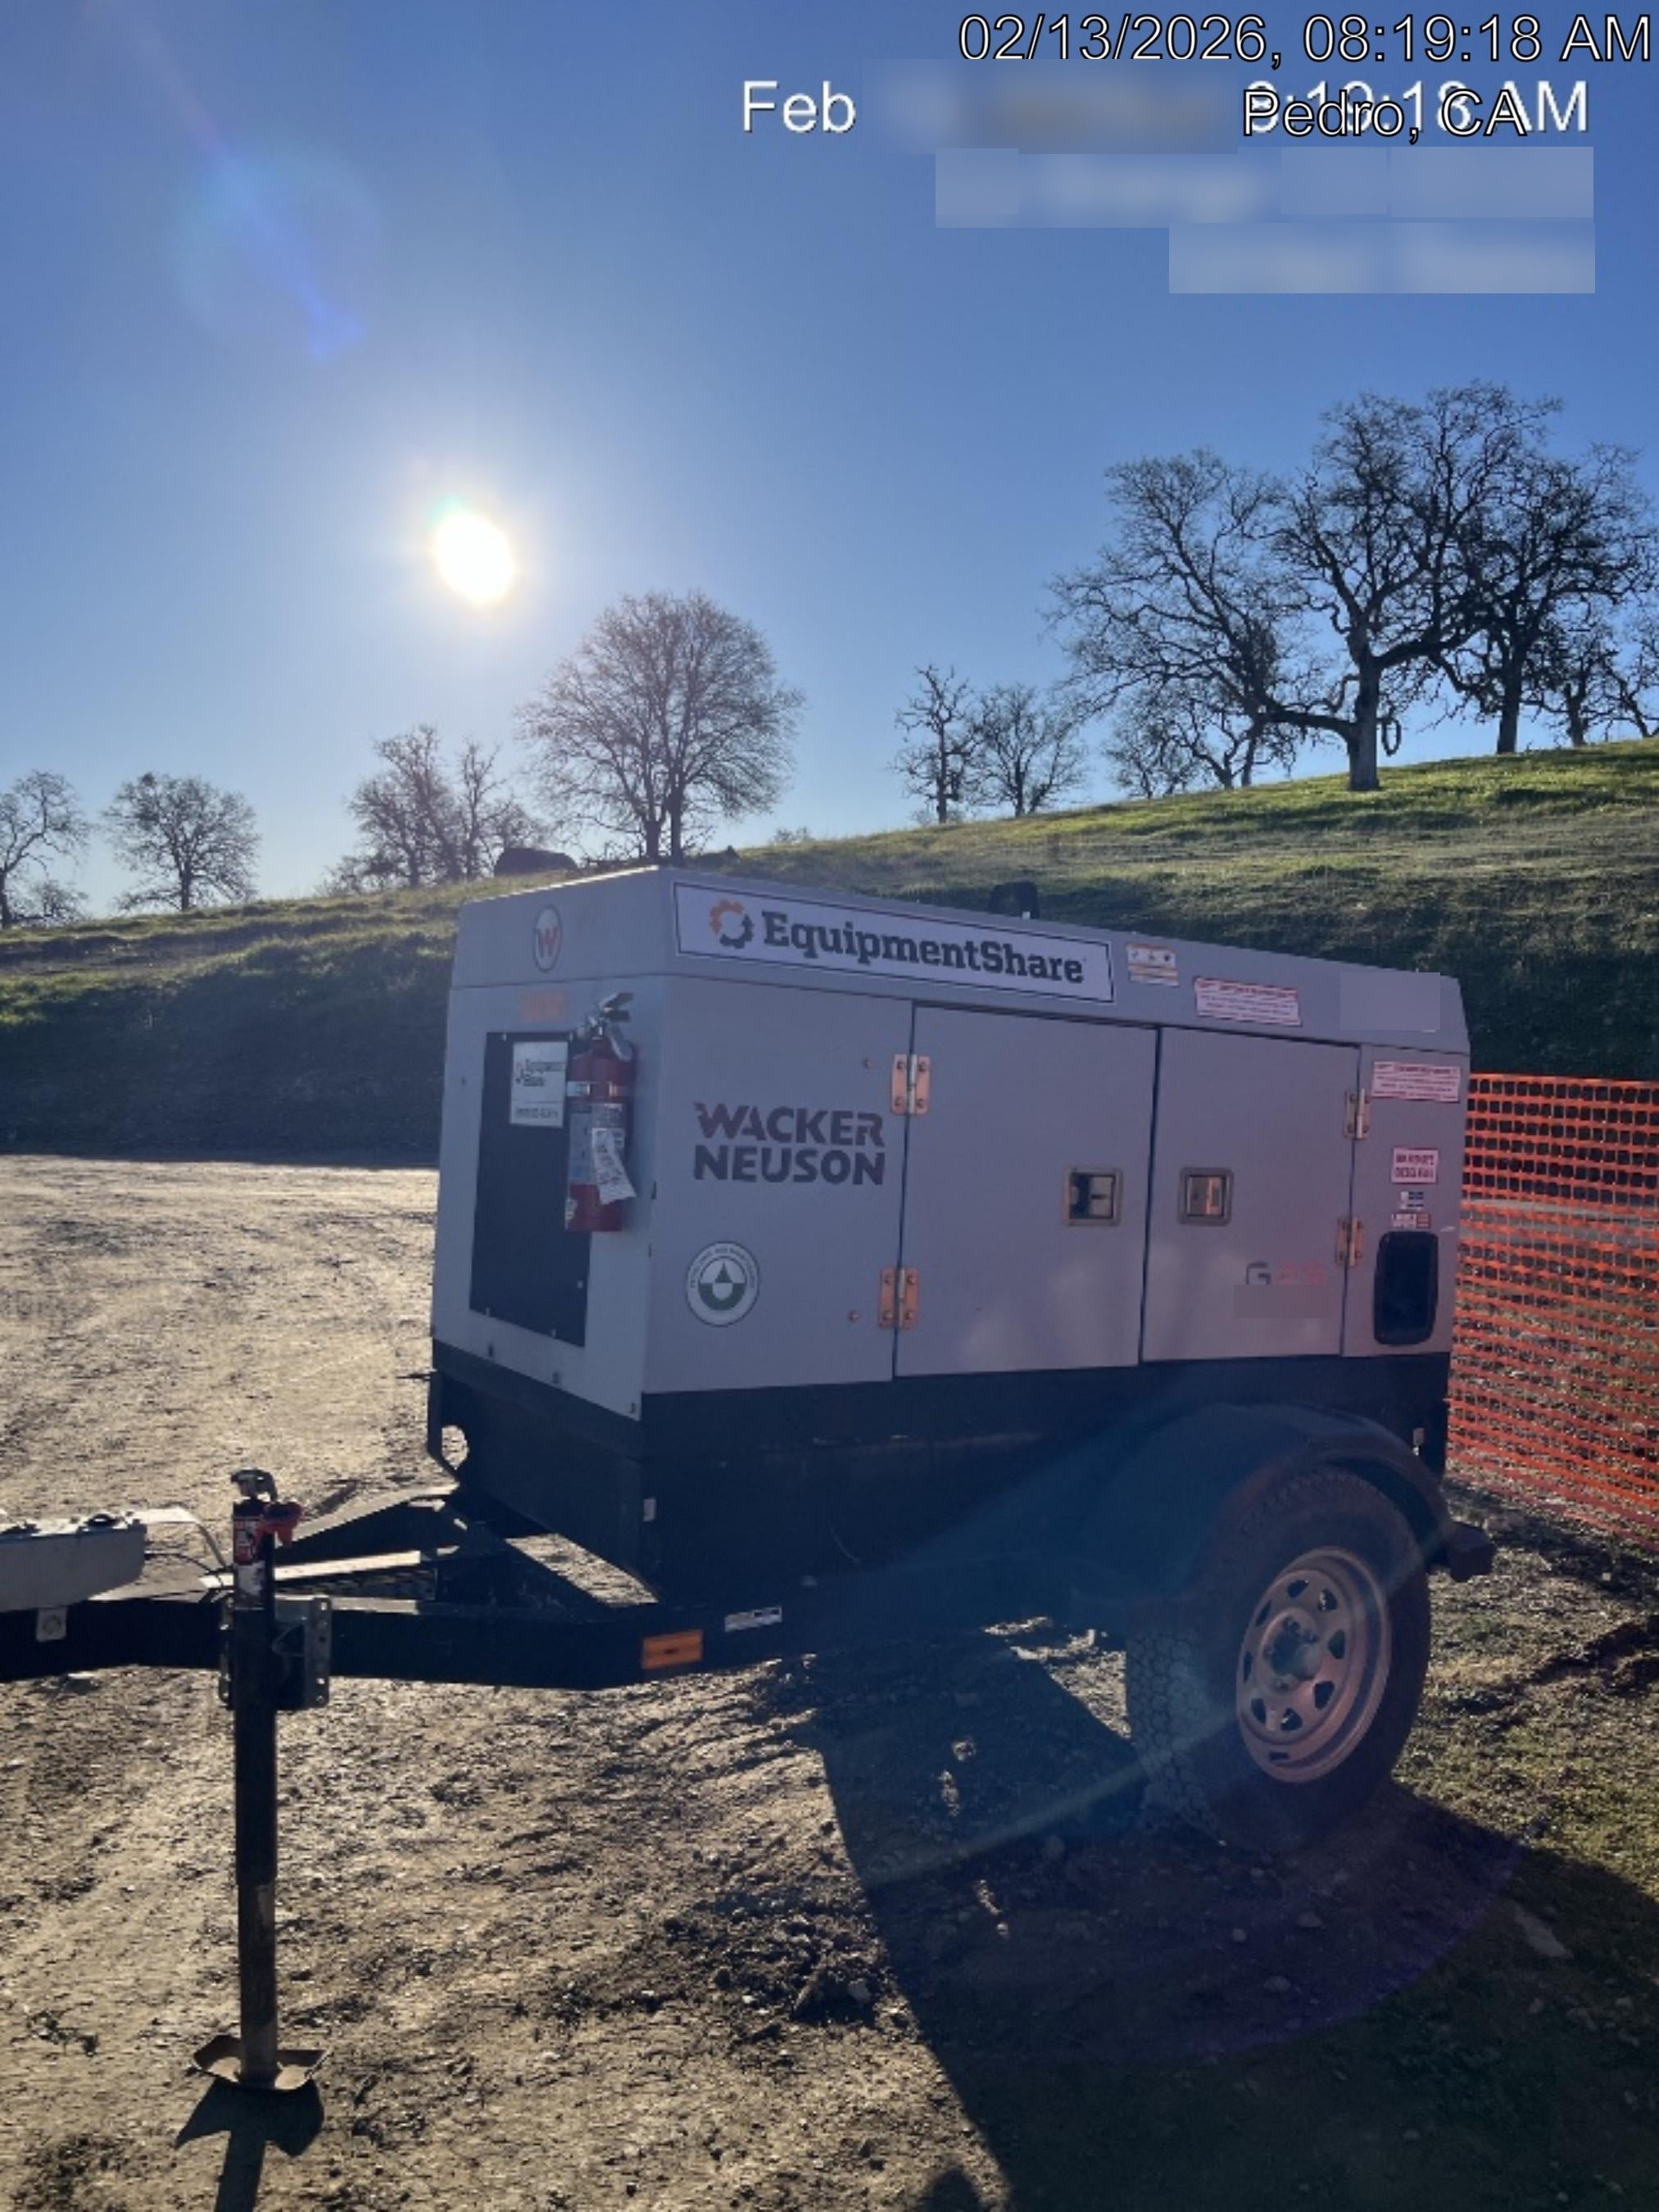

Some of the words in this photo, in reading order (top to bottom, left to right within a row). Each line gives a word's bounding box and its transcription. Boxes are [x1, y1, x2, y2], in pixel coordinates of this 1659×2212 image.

[762, 910, 1085, 983] EquipmentShare
[693, 1101, 886, 1147] WACKER
[692, 1144, 886, 1185] NEUSON
